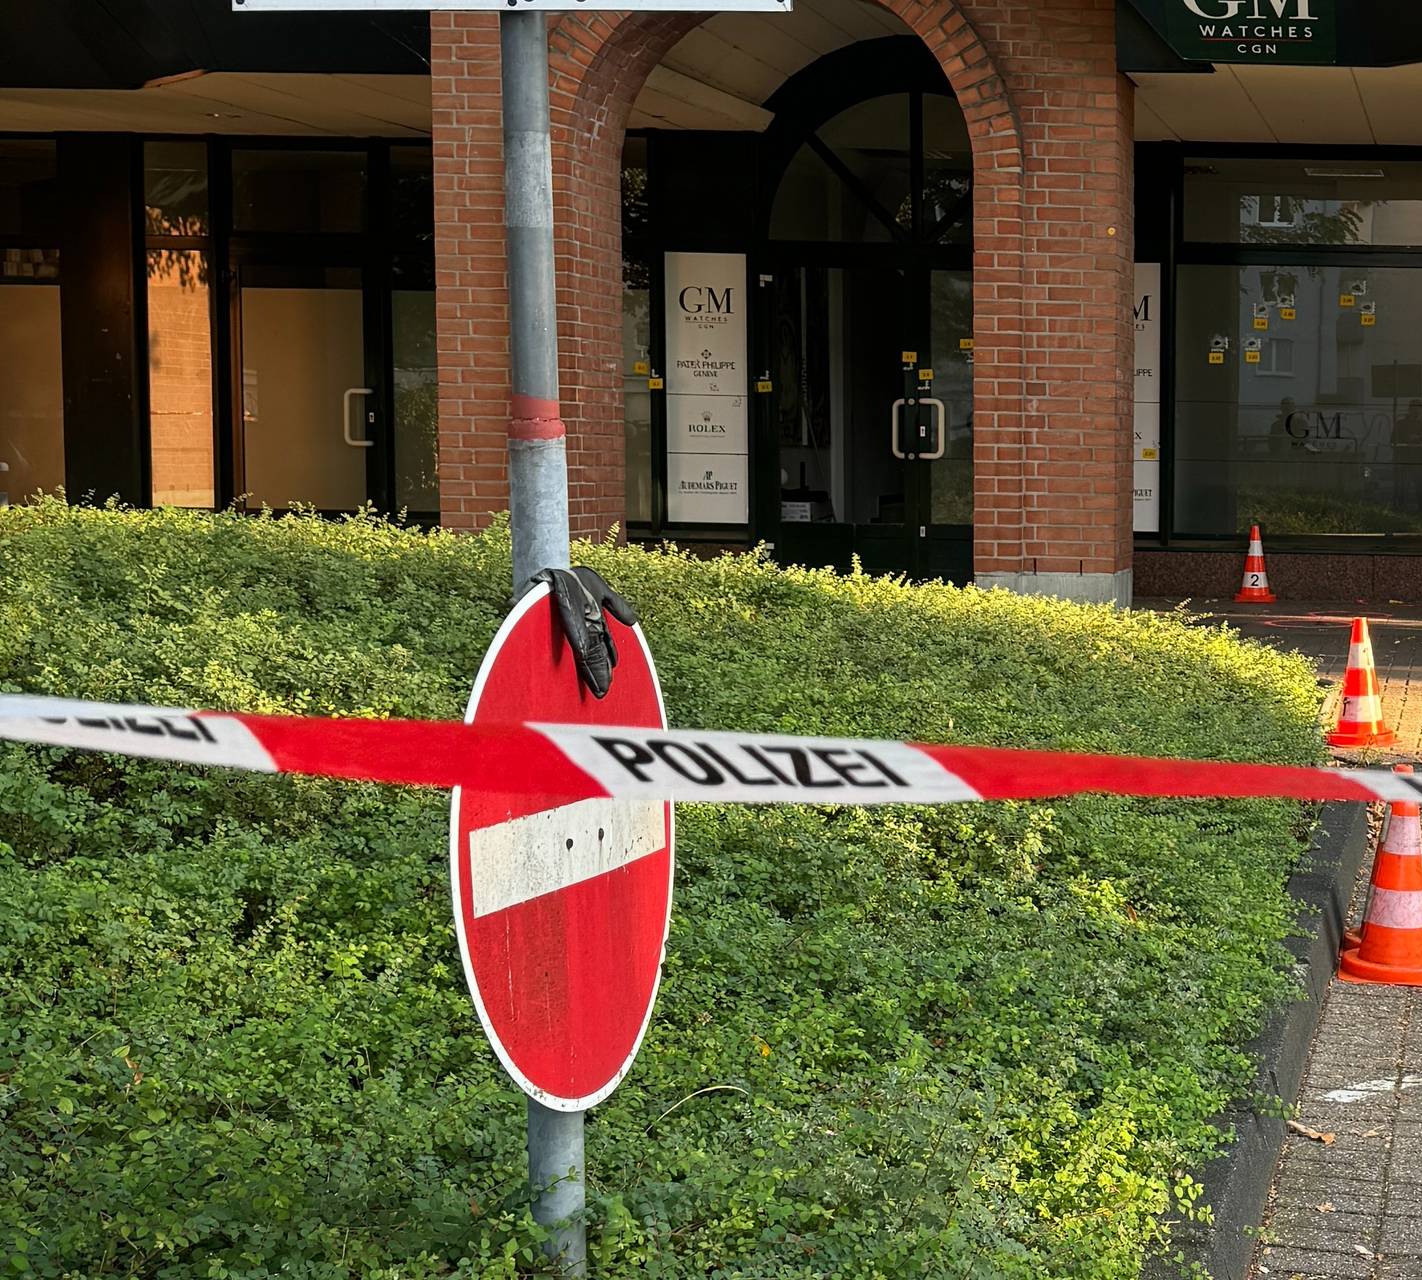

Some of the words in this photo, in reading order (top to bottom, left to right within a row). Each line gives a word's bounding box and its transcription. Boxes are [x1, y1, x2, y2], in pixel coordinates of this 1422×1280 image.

[1199, 24, 1313, 38] WATCHES
[1237, 44, 1277, 54] CGN
[678, 285, 735, 315] GM
[1133, 294, 1153, 322] M
[702, 360, 736, 371] PHILIPPE
[688, 424, 726, 433] ROLEX
[1284, 409, 1345, 440] GM
[678, 480, 715, 491] AUDEMARS
[715, 480, 738, 491] PIGUET
[1134, 488, 1153, 497] IGUET
[1250, 573, 1260, 587] 2
[591, 735, 913, 790] POLIZEI
